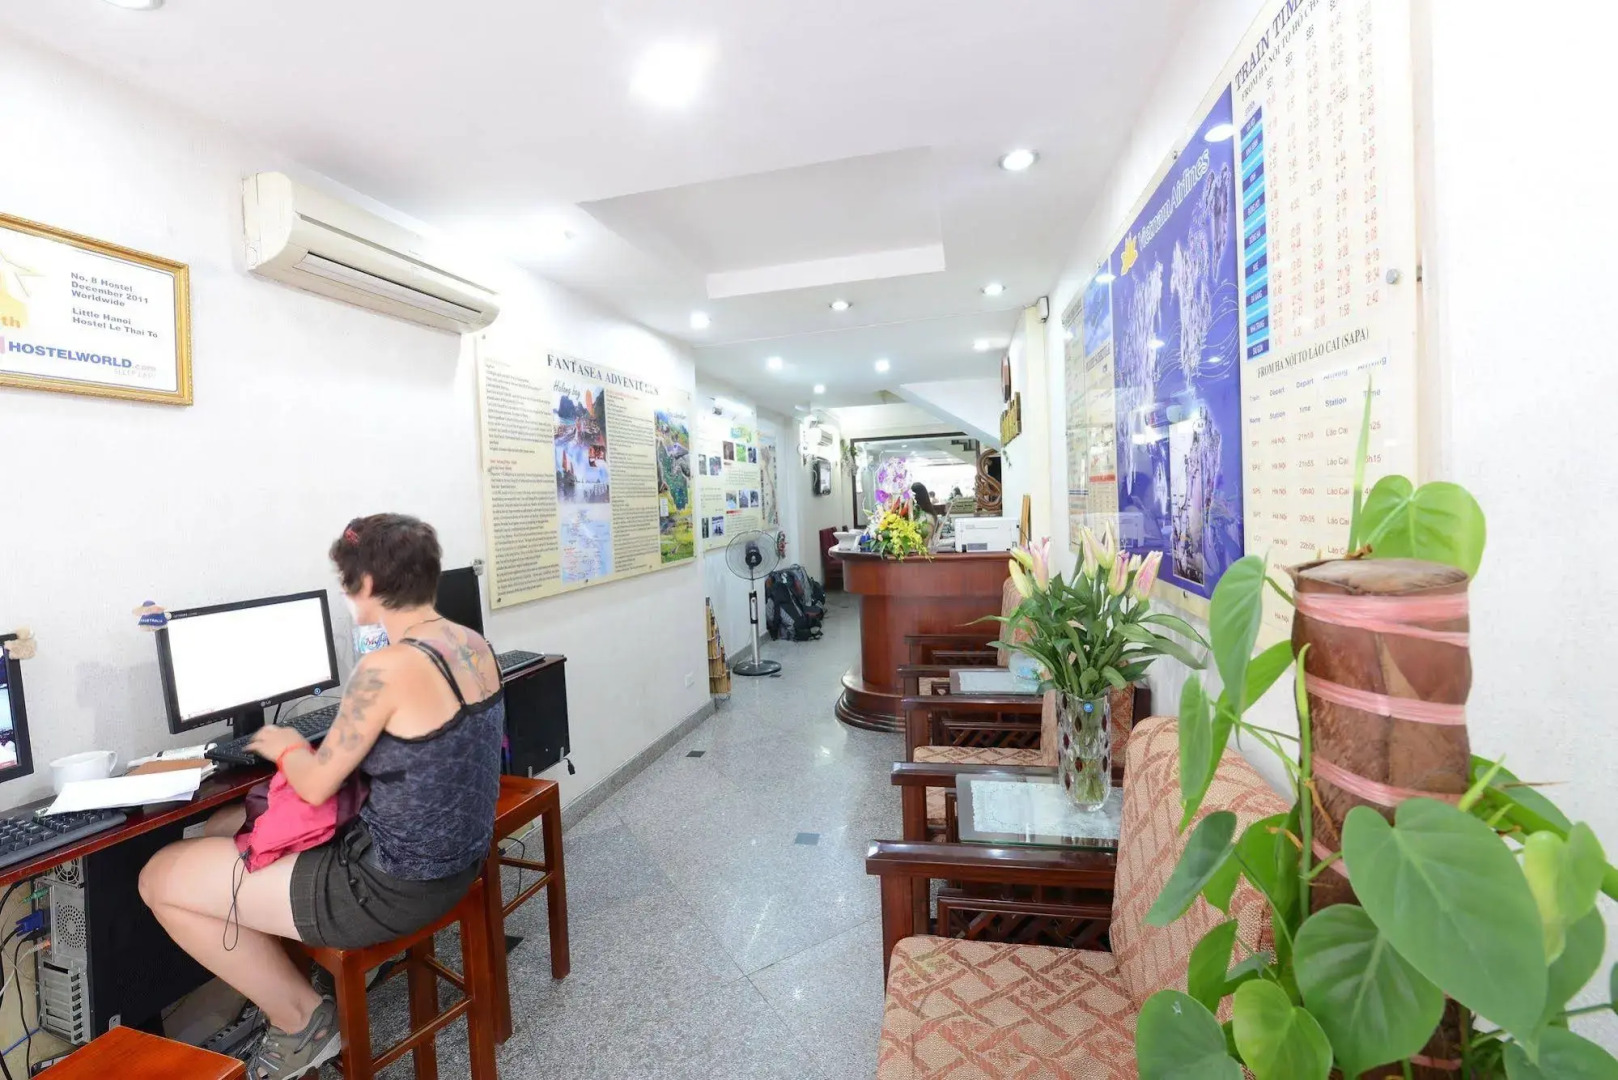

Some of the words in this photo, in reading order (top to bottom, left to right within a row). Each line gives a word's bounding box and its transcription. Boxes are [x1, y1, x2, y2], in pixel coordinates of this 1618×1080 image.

[1235, 28, 1269, 91] TRAIN
[1171, 149, 1210, 208] Airlines
[71, 272, 88, 282] No.
[101, 279, 133, 292] Hostel
[71, 281, 123, 298] December
[127, 293, 148, 304] 2011
[71, 289, 125, 307] Worldwide
[72, 316, 106, 329] Hostel
[109, 323, 121, 332] Le
[124, 326, 145, 336] Thai
[73, 307, 100, 319] Little
[103, 314, 131, 325] Hanoi
[1257, 364, 1275, 378] FROM
[1298, 350, 1308, 363] TO
[1341, 328, 1369, 350] (SAPA)
[547, 354, 602, 381] FANTASEA
[1296, 378, 1314, 389] Depart
[1325, 397, 1347, 408] Station
[1363, 389, 1381, 398] Tme
